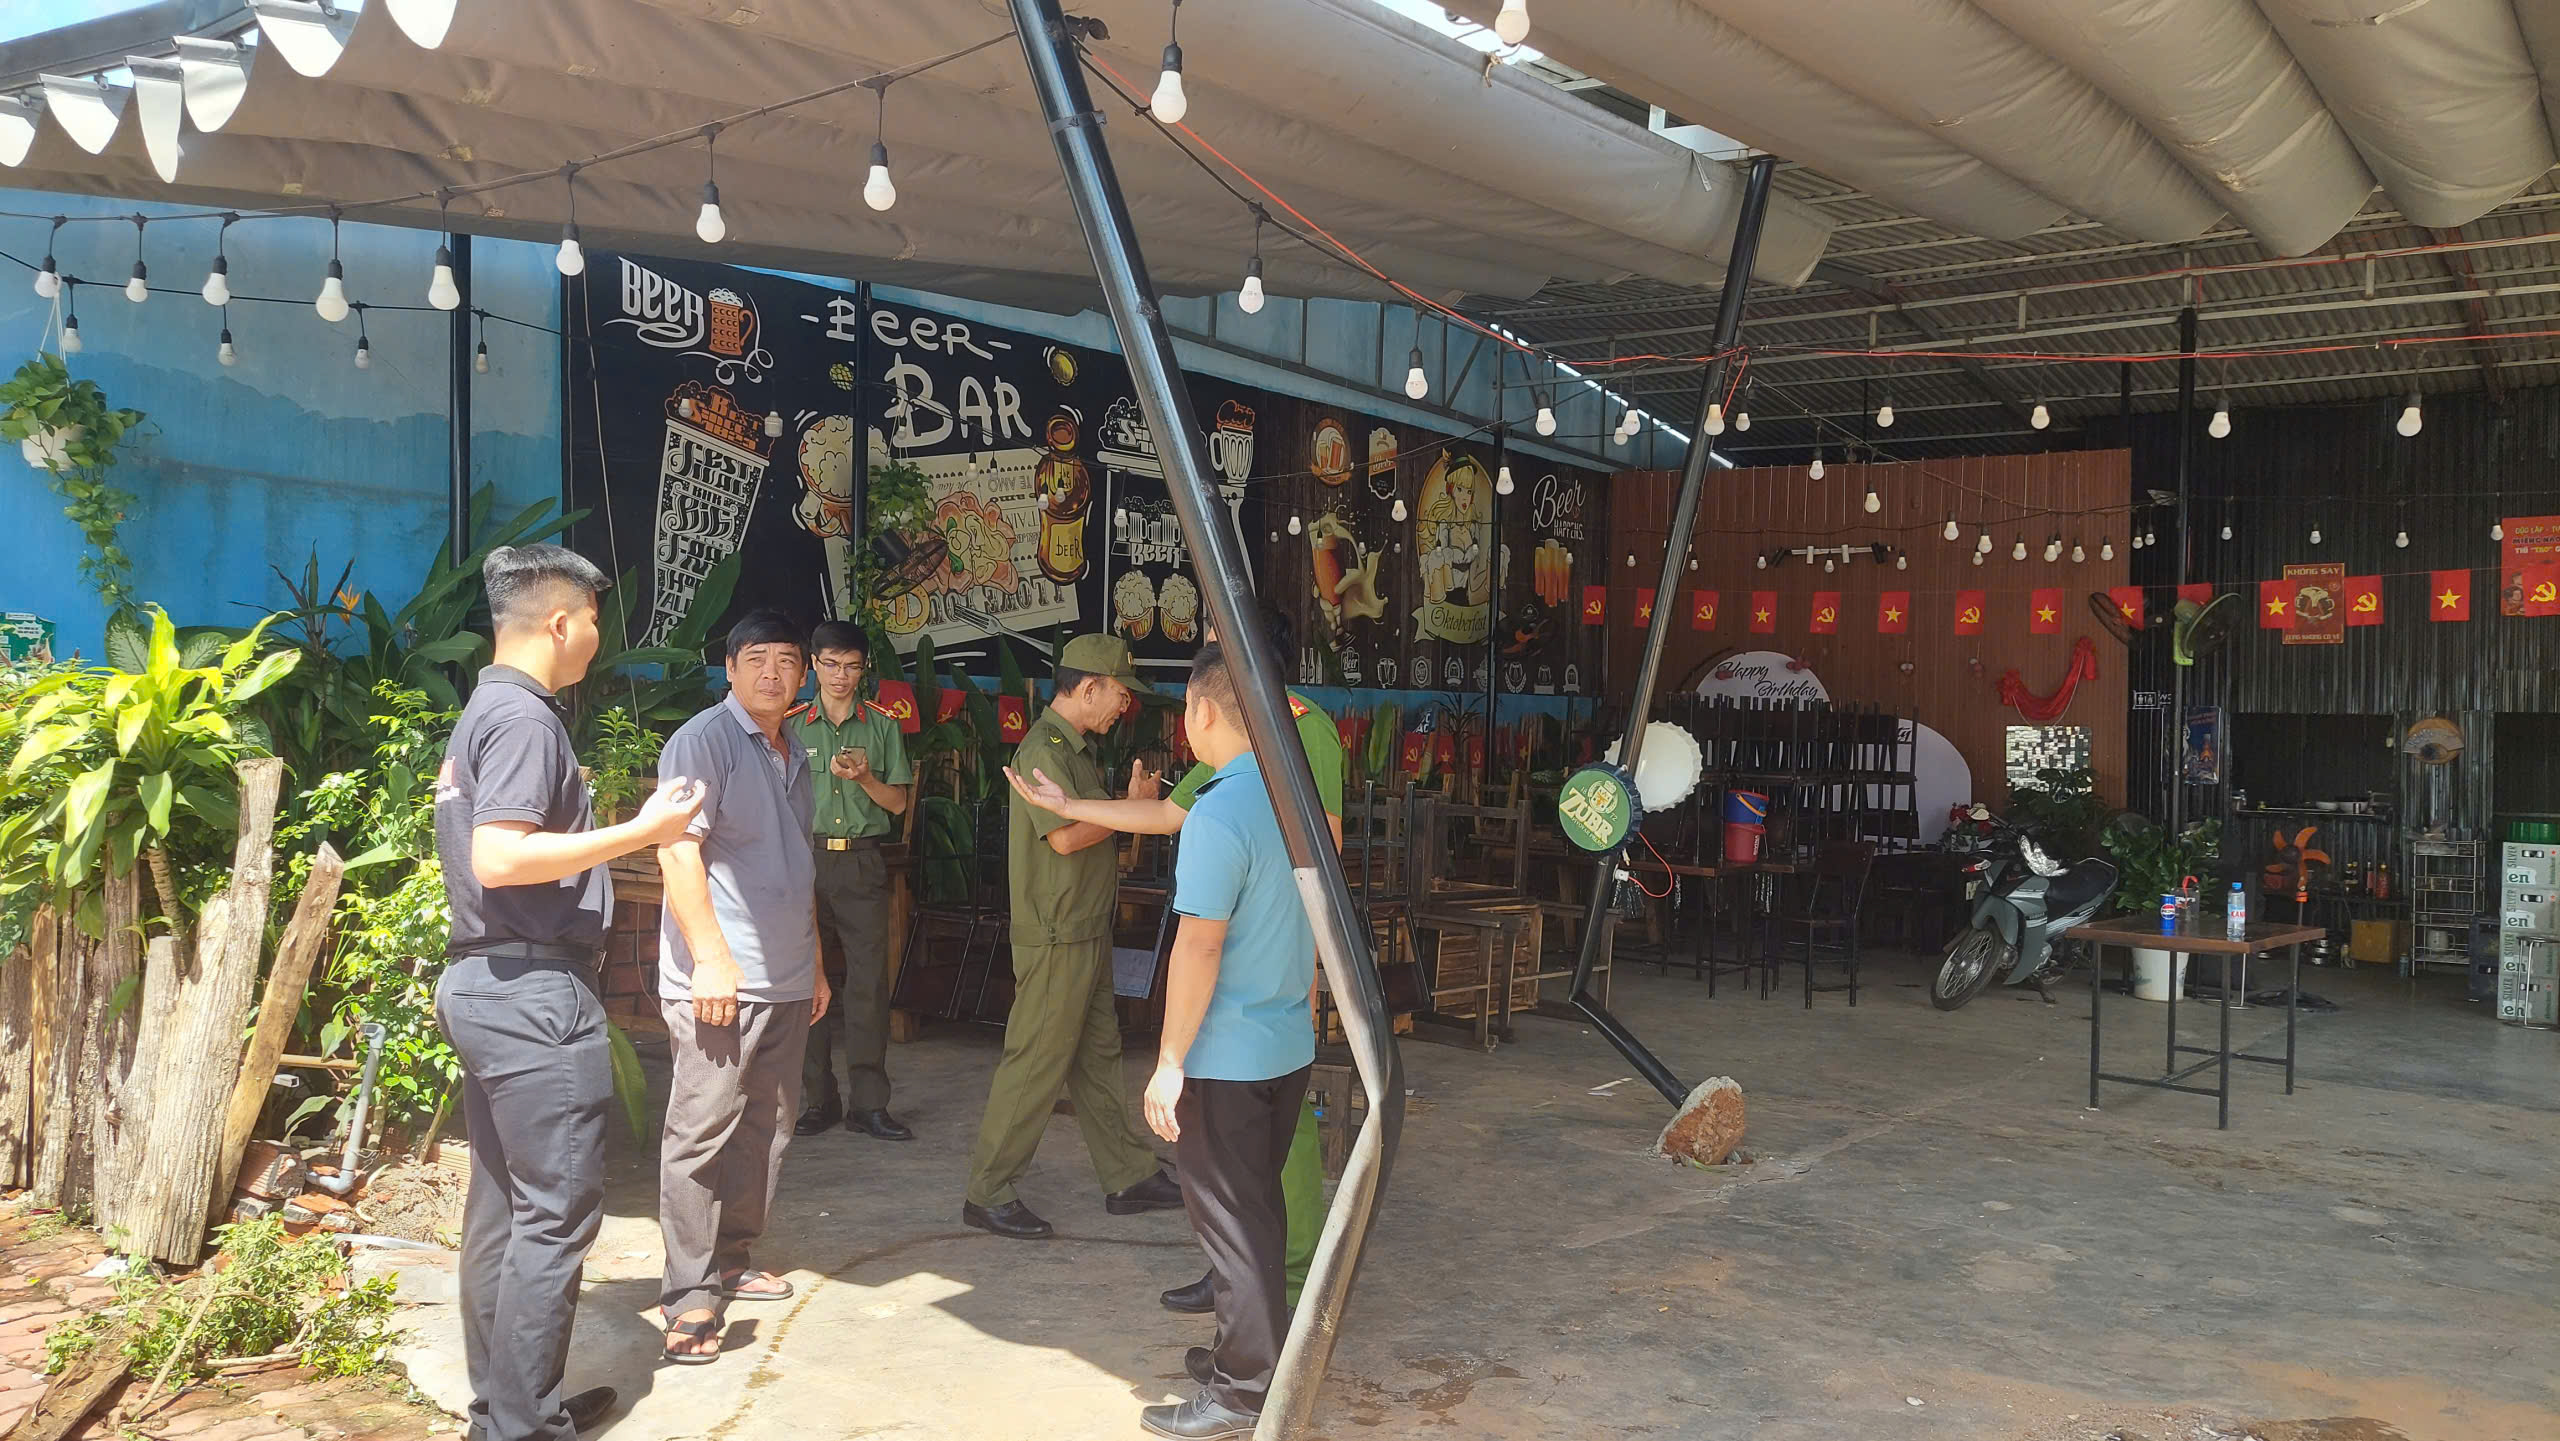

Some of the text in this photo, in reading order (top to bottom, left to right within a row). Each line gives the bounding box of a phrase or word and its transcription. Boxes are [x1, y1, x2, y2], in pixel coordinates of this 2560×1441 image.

[883, 352, 1033, 448] BAR
[1532, 474, 1587, 531] Beer
[2320, 567, 2340, 575] SAY
[1430, 606, 1488, 640] Oktoberfest
[1754, 679, 1819, 700] Birthday
[1559, 787, 1614, 845] ZUBR
[2506, 845, 2516, 868] SILVER
[2506, 889, 2516, 912] SILVER
[2504, 933, 2515, 956] SILVER
[2503, 978, 2513, 1000] SILVER
